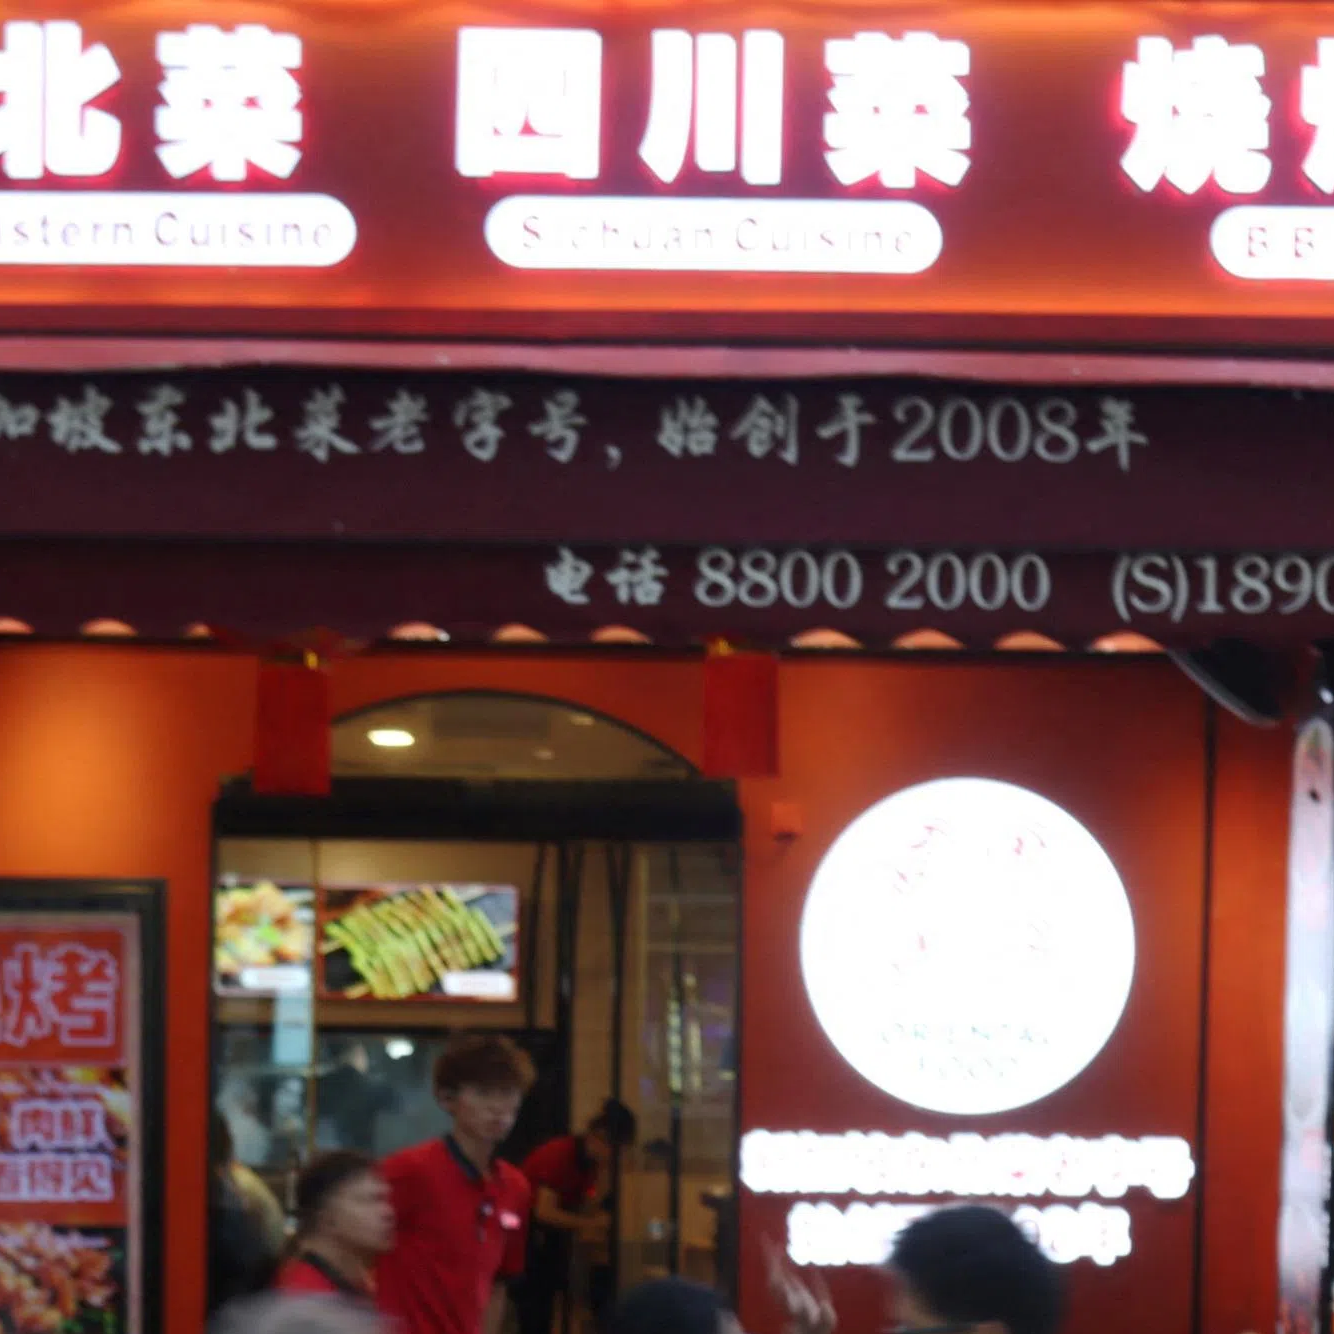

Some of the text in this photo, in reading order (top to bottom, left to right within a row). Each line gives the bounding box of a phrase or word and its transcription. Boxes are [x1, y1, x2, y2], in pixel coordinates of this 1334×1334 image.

[454, 25, 972, 189] 四川菜
[153, 210, 333, 249] Cuisine
[521, 214, 715, 250] Schuan
[545, 547, 668, 607] 电话
[694, 550, 863, 609] 8800
[885, 552, 1051, 611] 2000
